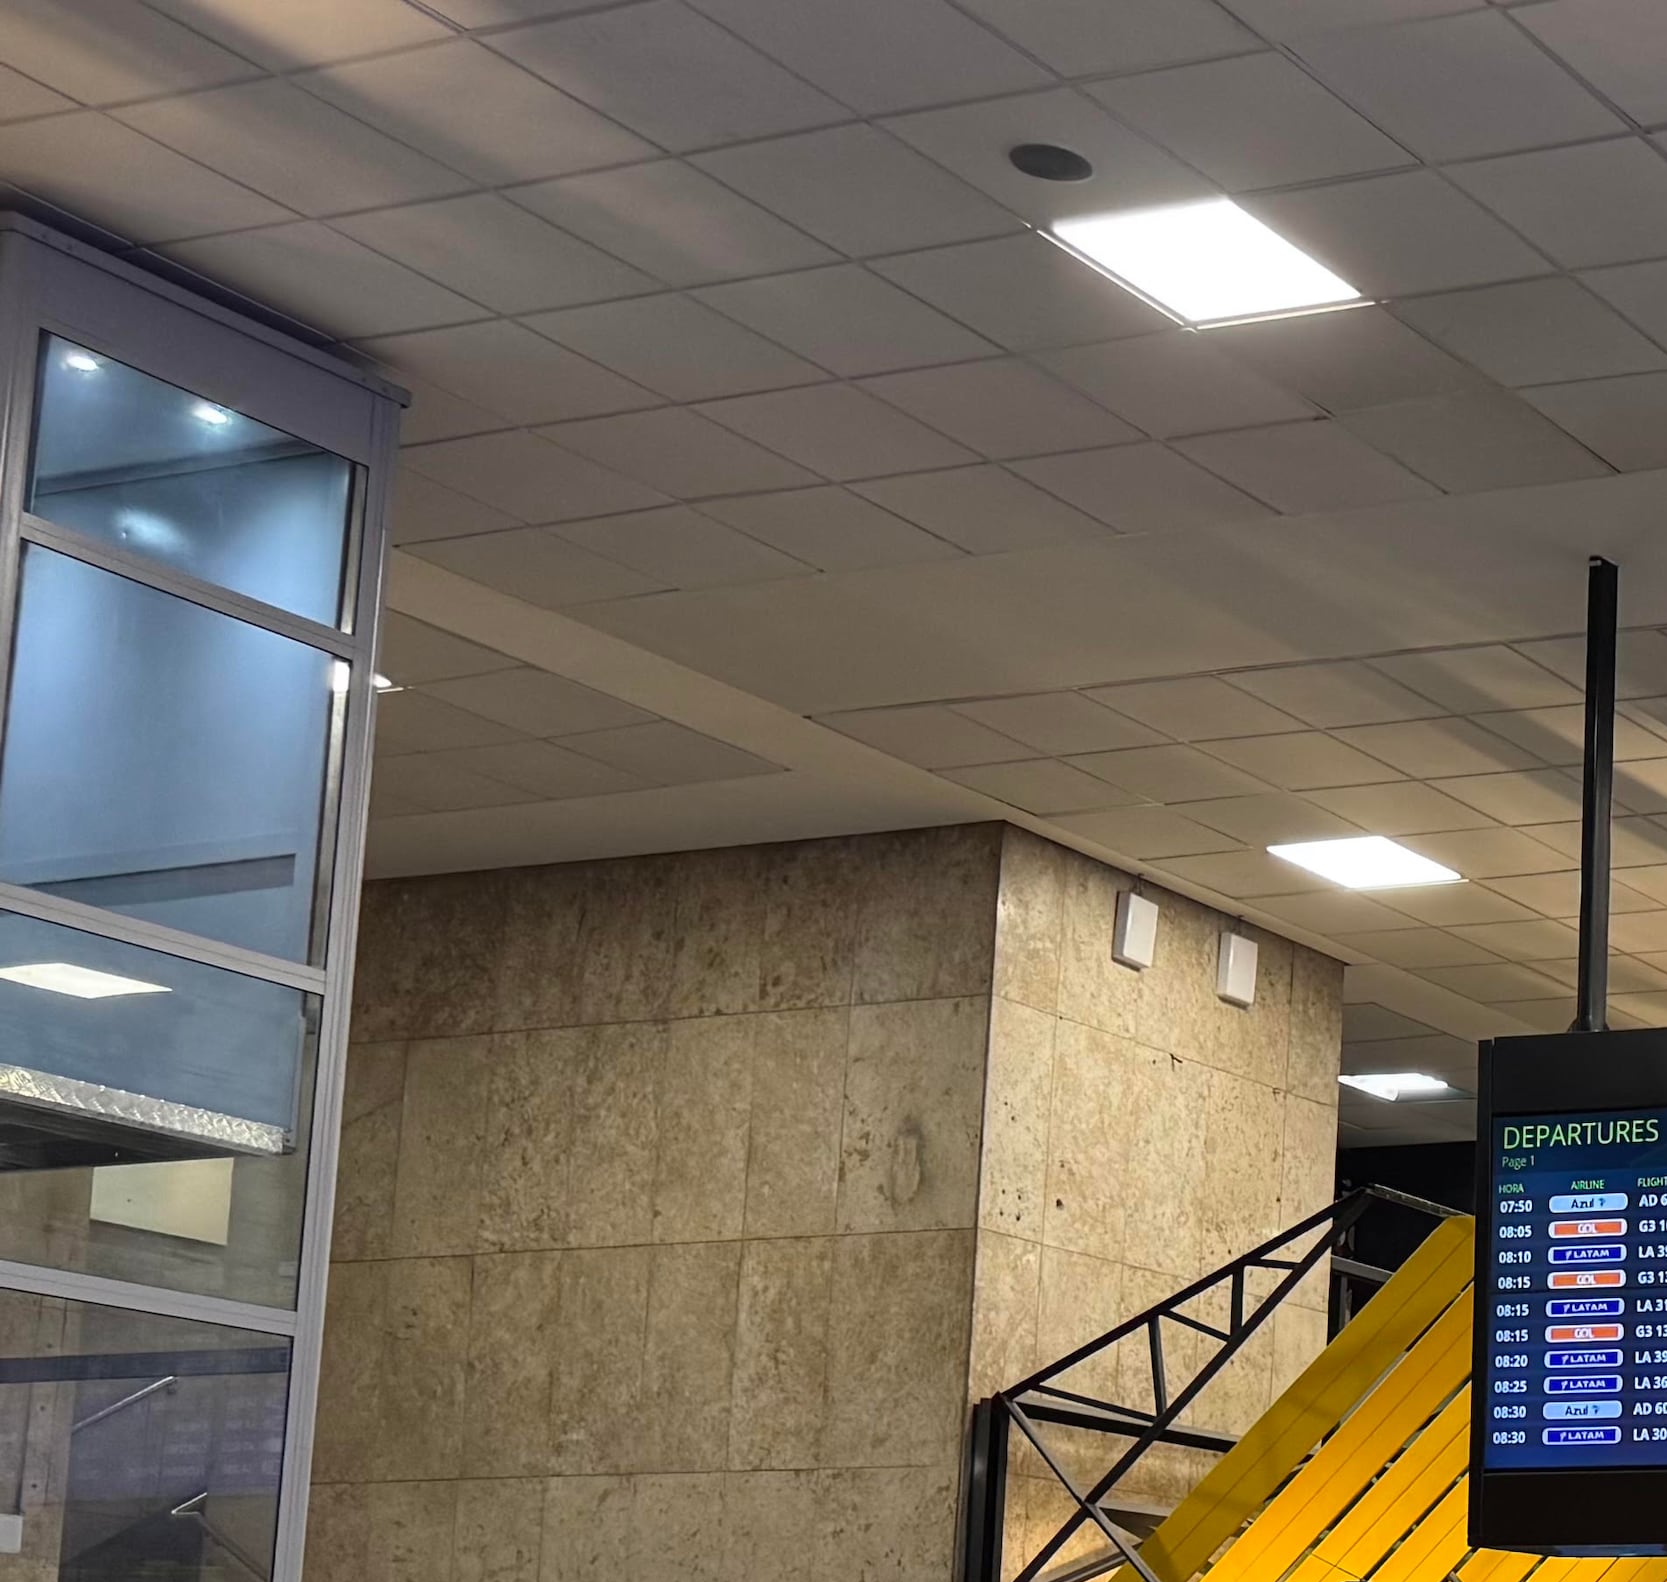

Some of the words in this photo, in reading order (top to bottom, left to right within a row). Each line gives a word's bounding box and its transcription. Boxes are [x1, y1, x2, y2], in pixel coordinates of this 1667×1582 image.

[1503, 1118, 1659, 1150] DEPARTURES
[1502, 1156, 1527, 1171] Page
[1530, 1155, 1535, 1167] 1
